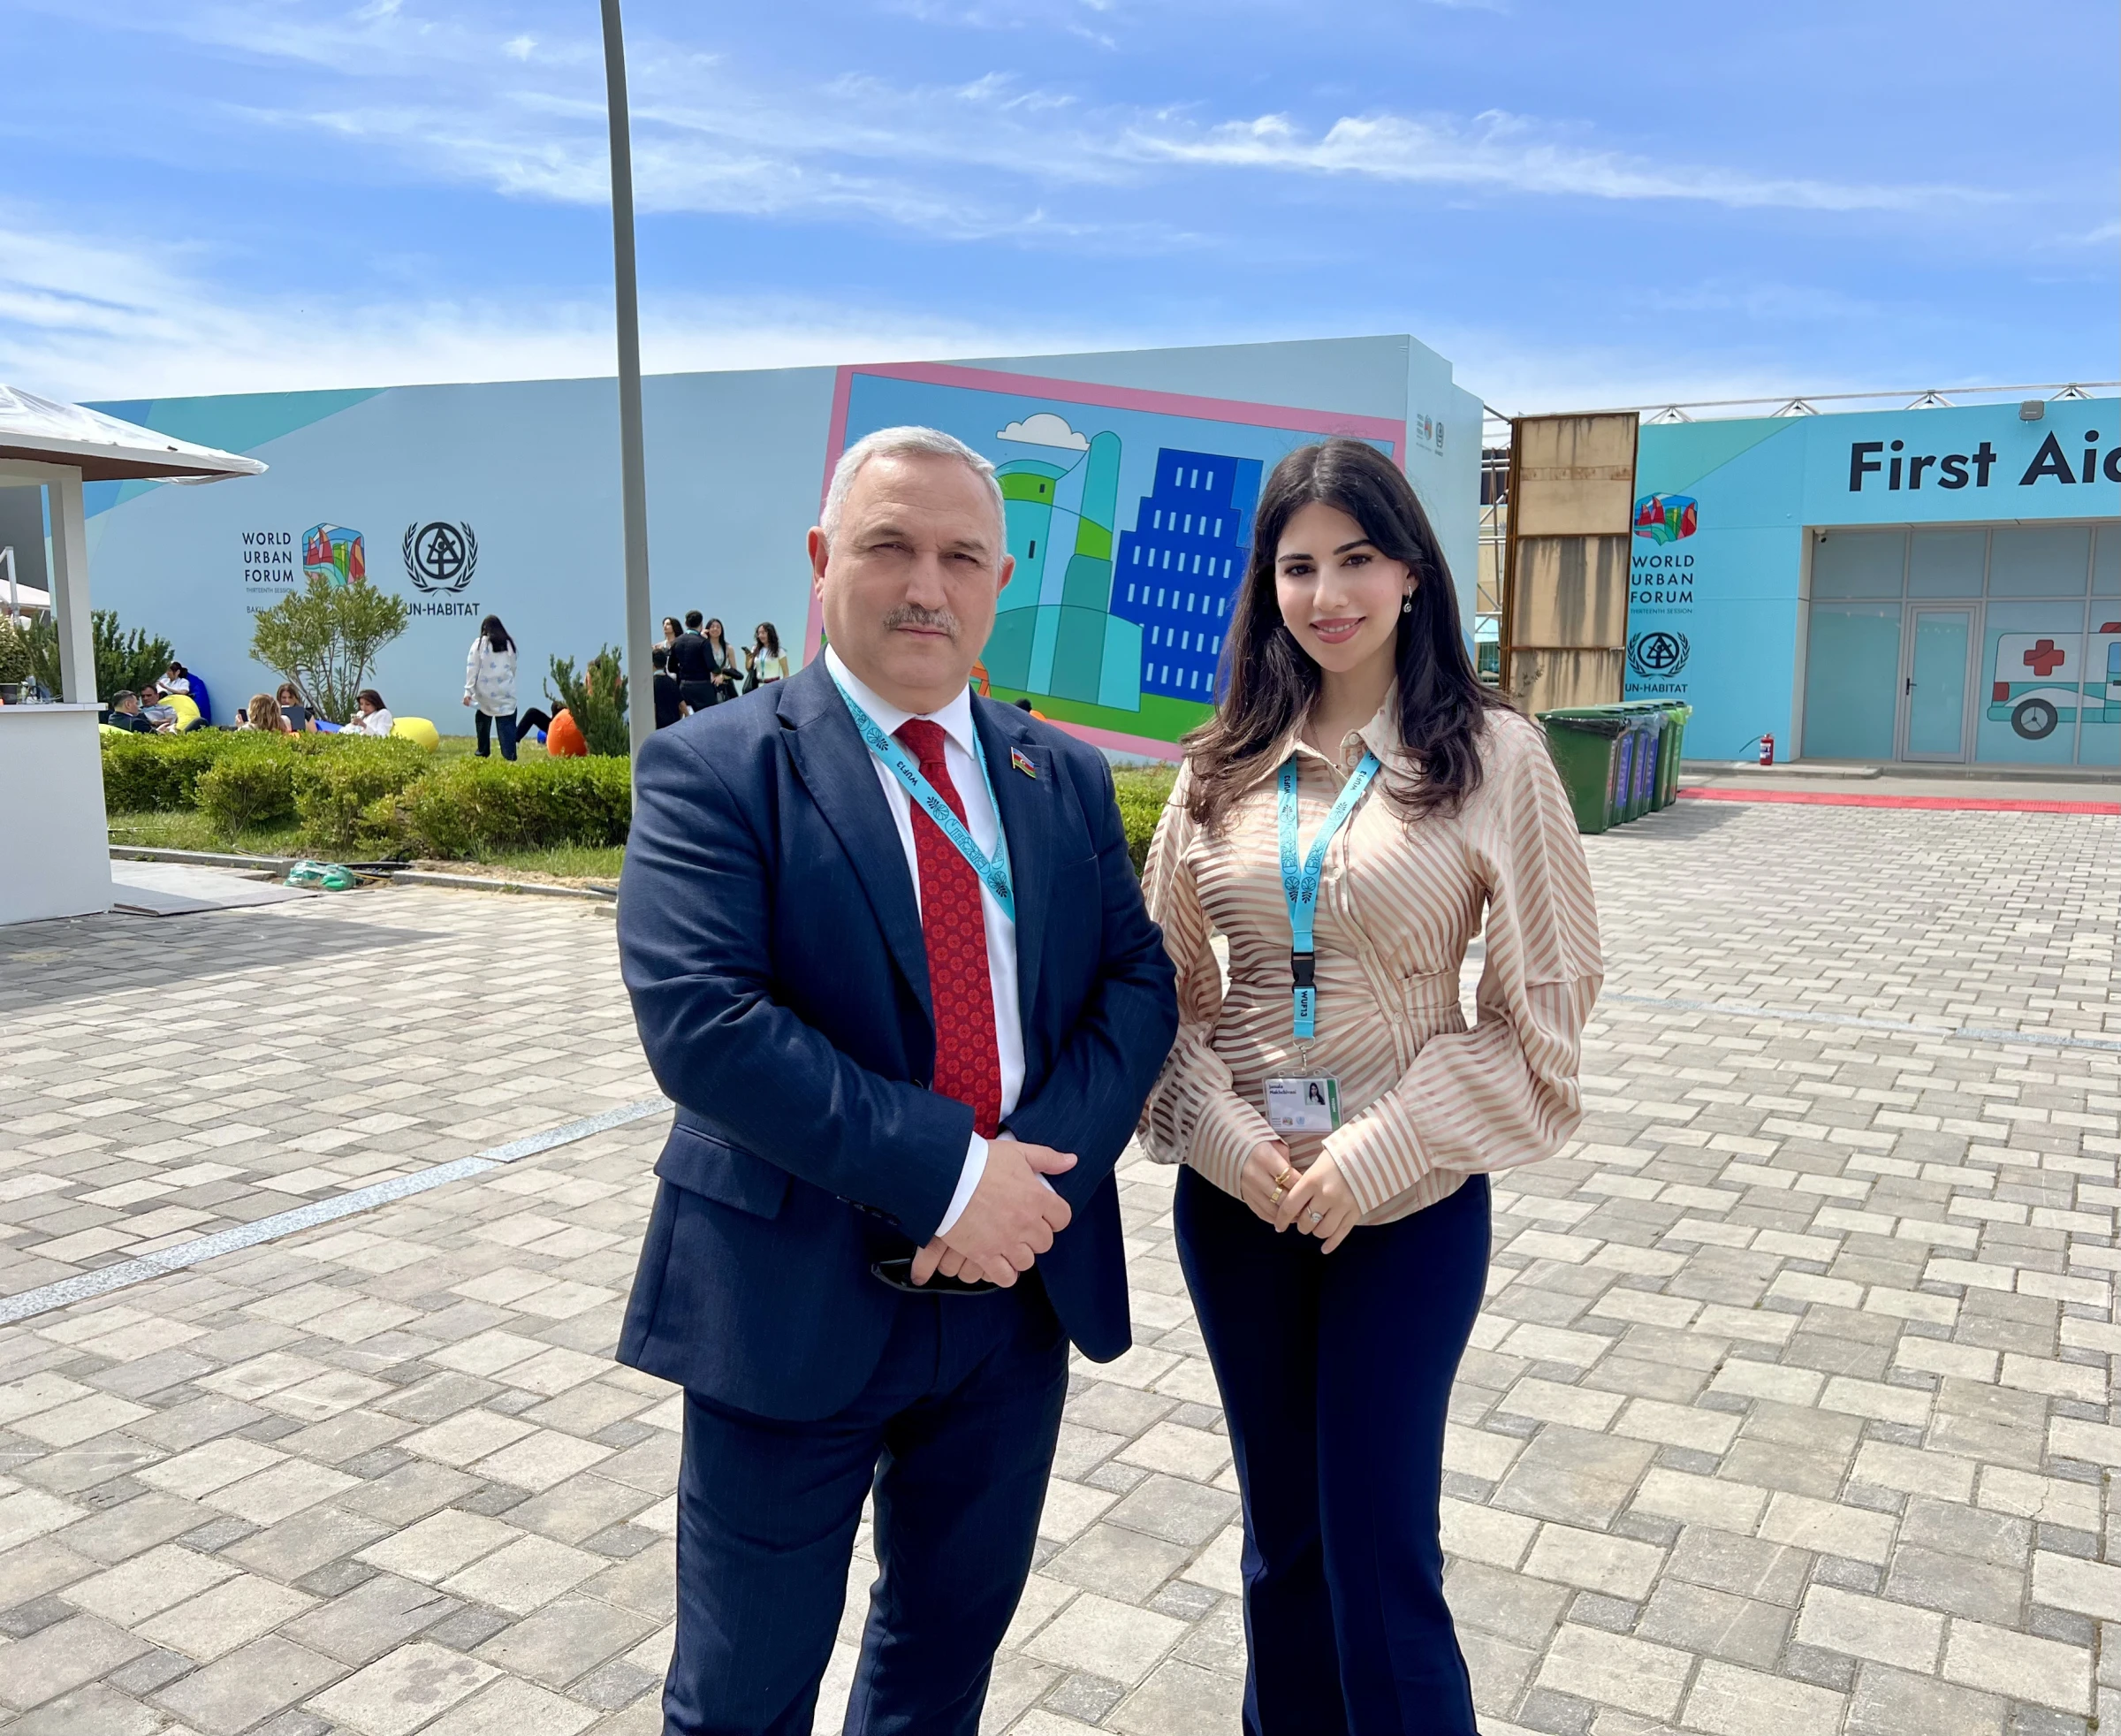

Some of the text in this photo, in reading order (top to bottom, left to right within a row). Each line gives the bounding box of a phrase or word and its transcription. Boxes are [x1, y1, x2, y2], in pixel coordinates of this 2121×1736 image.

[1849, 439, 1997, 492] First
[242, 533, 291, 545] WORLD
[244, 551, 292, 563] URBAN
[1632, 555, 1694, 567] WORLD
[245, 569, 293, 582] FORUM
[1631, 573, 1693, 586] URBAN
[1631, 591, 1693, 604] FORUM
[405, 603, 480, 615] UN-HABITAT
[1625, 683, 1688, 693] UN-HABITAT
[896, 760, 918, 787] WUF13
[1351, 771, 1366, 790] WUF13
